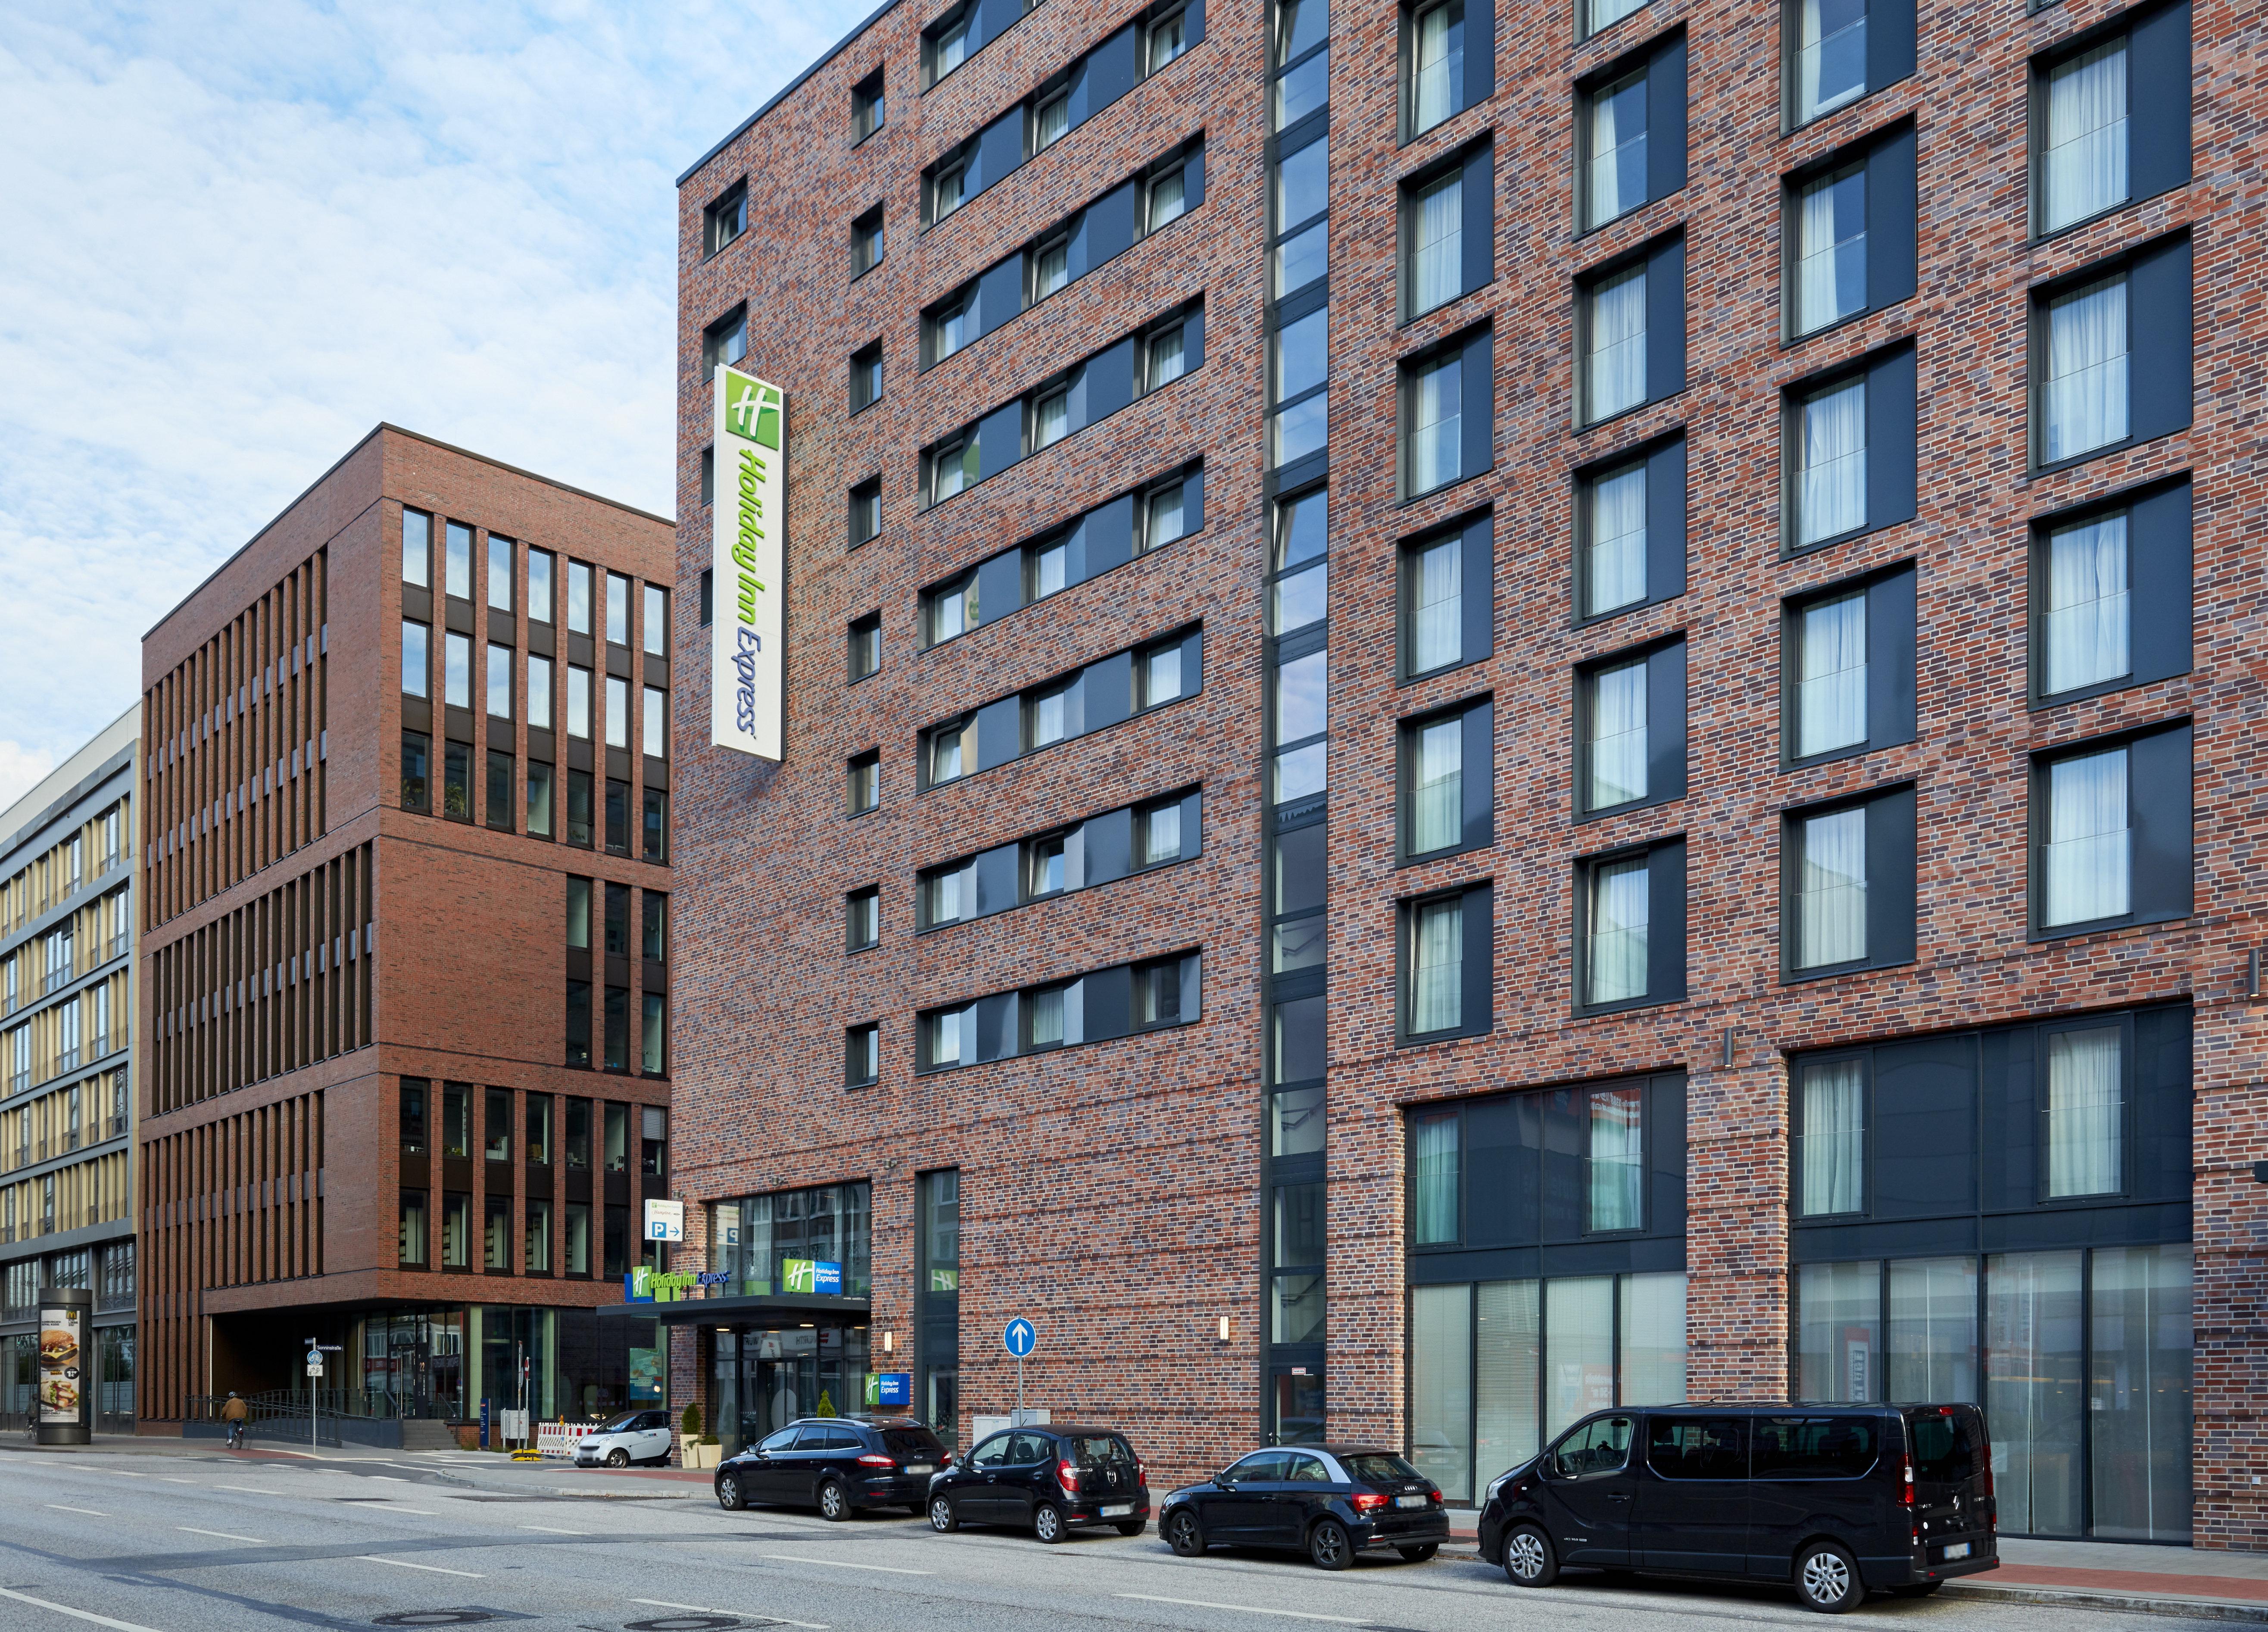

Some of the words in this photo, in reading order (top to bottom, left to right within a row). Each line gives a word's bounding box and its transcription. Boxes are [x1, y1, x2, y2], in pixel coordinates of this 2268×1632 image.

[731, 448, 767, 572] Holiday
[736, 572, 766, 625] Inn
[730, 625, 762, 736] Express
[655, 1223, 664, 1236] P
[651, 1272, 683, 1290] Holiday
[683, 1270, 697, 1285] Inn
[697, 1271, 730, 1288] Express
[816, 1274, 839, 1283] Express
[419, 1362, 425, 1372] 22
[881, 1386, 899, 1394] Express
